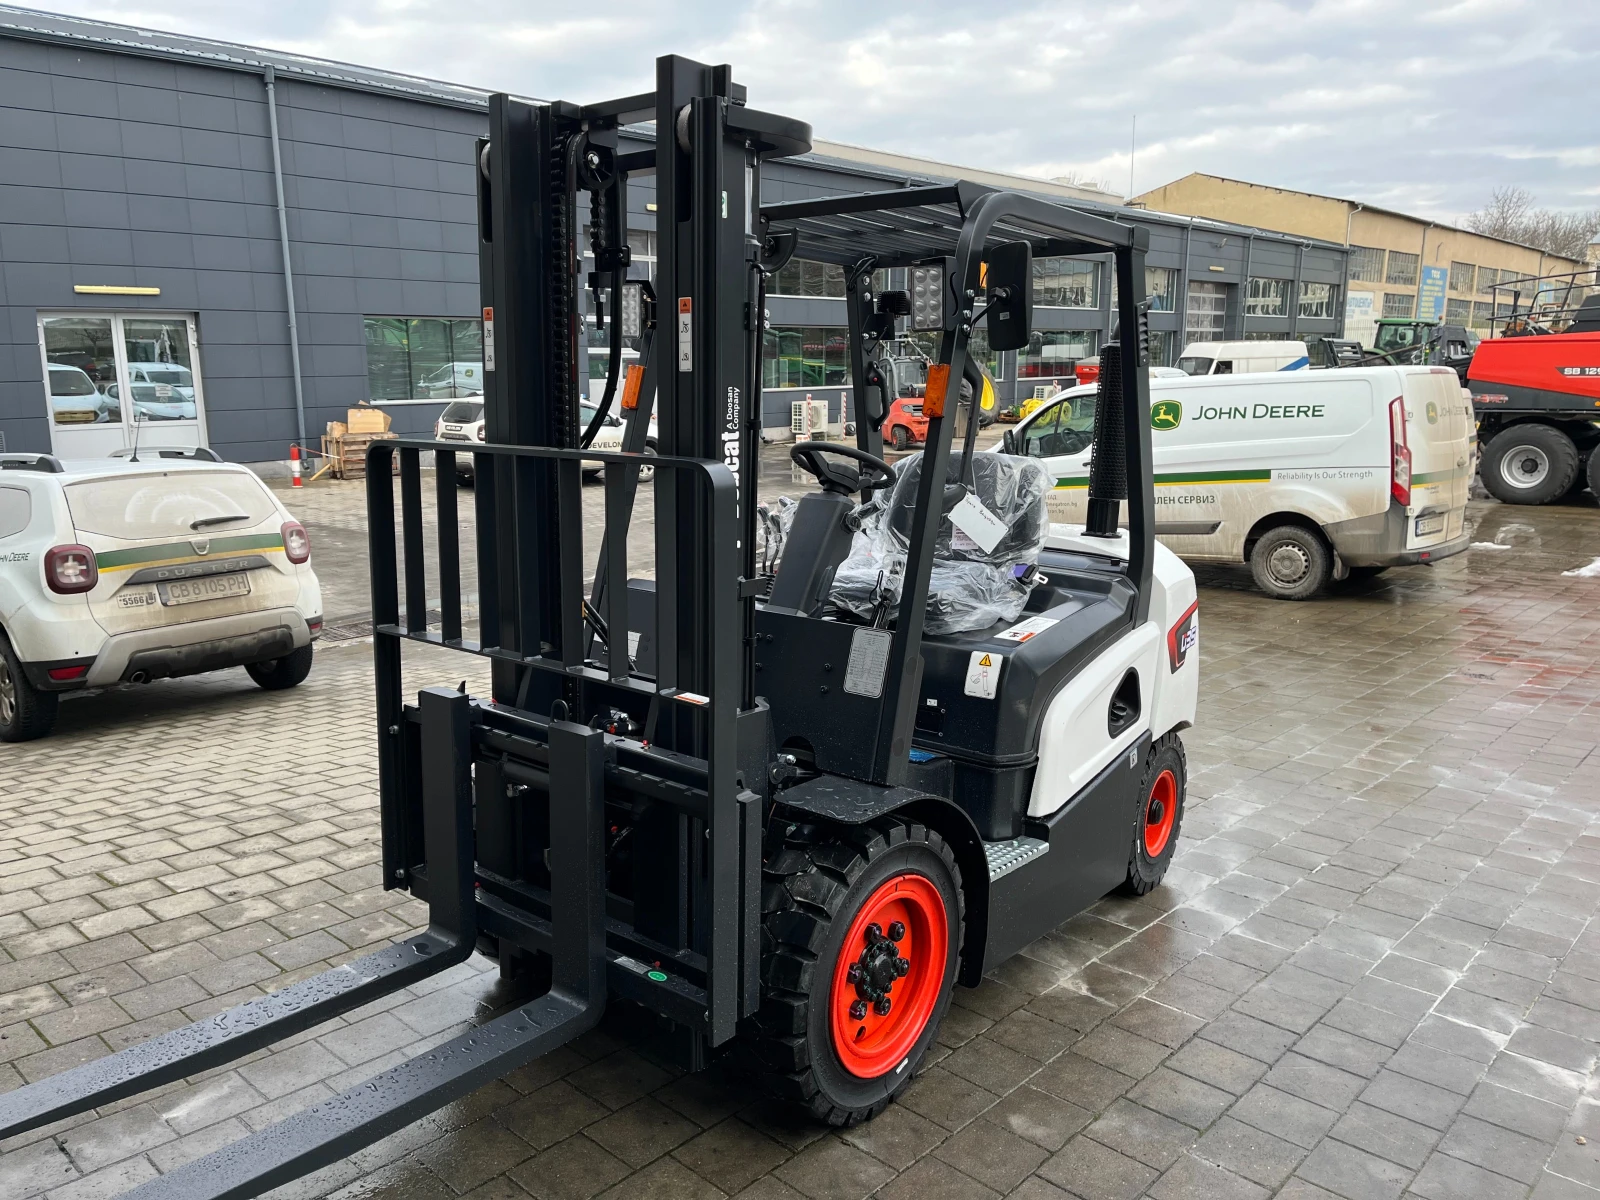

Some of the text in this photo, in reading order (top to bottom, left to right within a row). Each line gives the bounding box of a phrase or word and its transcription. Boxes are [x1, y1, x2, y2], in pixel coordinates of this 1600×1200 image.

[1564, 367, 1581, 375] SB
[732, 386, 740, 430] Company
[1192, 403, 1326, 420] JOHN DEERE
[726, 422, 733, 430] A
[1277, 470, 1373, 482] Reliability Is Our Strength
[1177, 495, 1216, 504] СЕРВИЗ
[9, 552, 31, 562] DEERE
[158, 560, 249, 578] DUSTER
[169, 583, 190, 599] CB
[192, 578, 227, 596] 8105
[227, 575, 247, 591] PH
